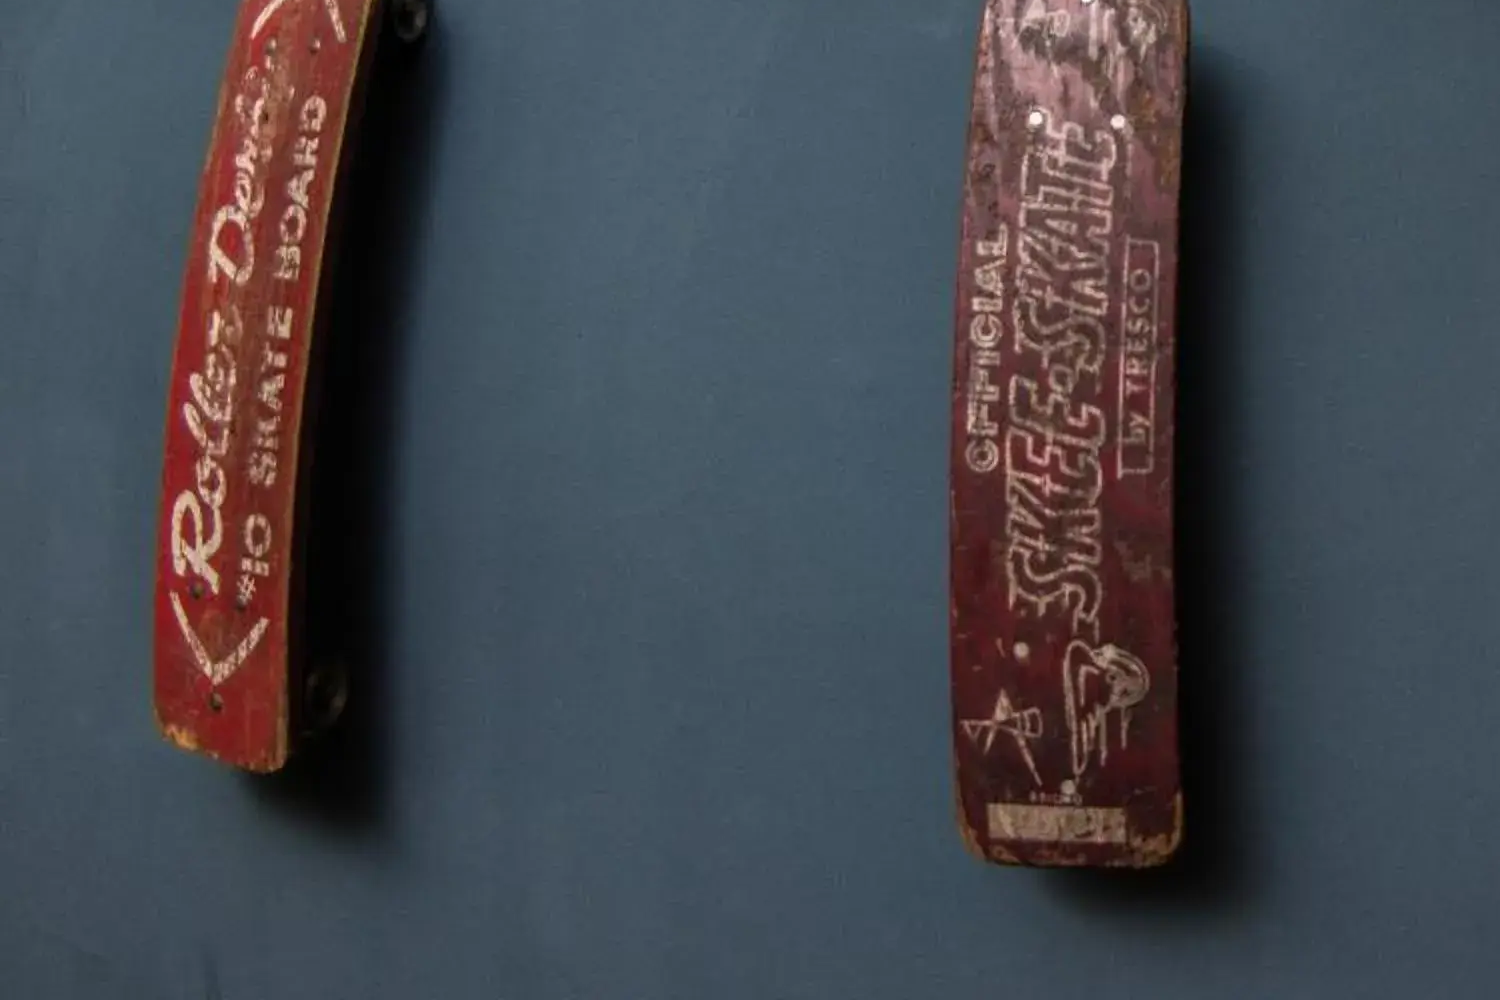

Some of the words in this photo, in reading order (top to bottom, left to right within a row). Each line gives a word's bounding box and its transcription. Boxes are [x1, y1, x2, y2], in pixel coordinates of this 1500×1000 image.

[274, 95, 328, 281] BOARD
[249, 304, 294, 489] SKATE
[965, 222, 1009, 474] OFFICIAL
[1124, 267, 1152, 398] TRESCO
[1122, 411, 1151, 444] by
[236, 513, 272, 605] #10
